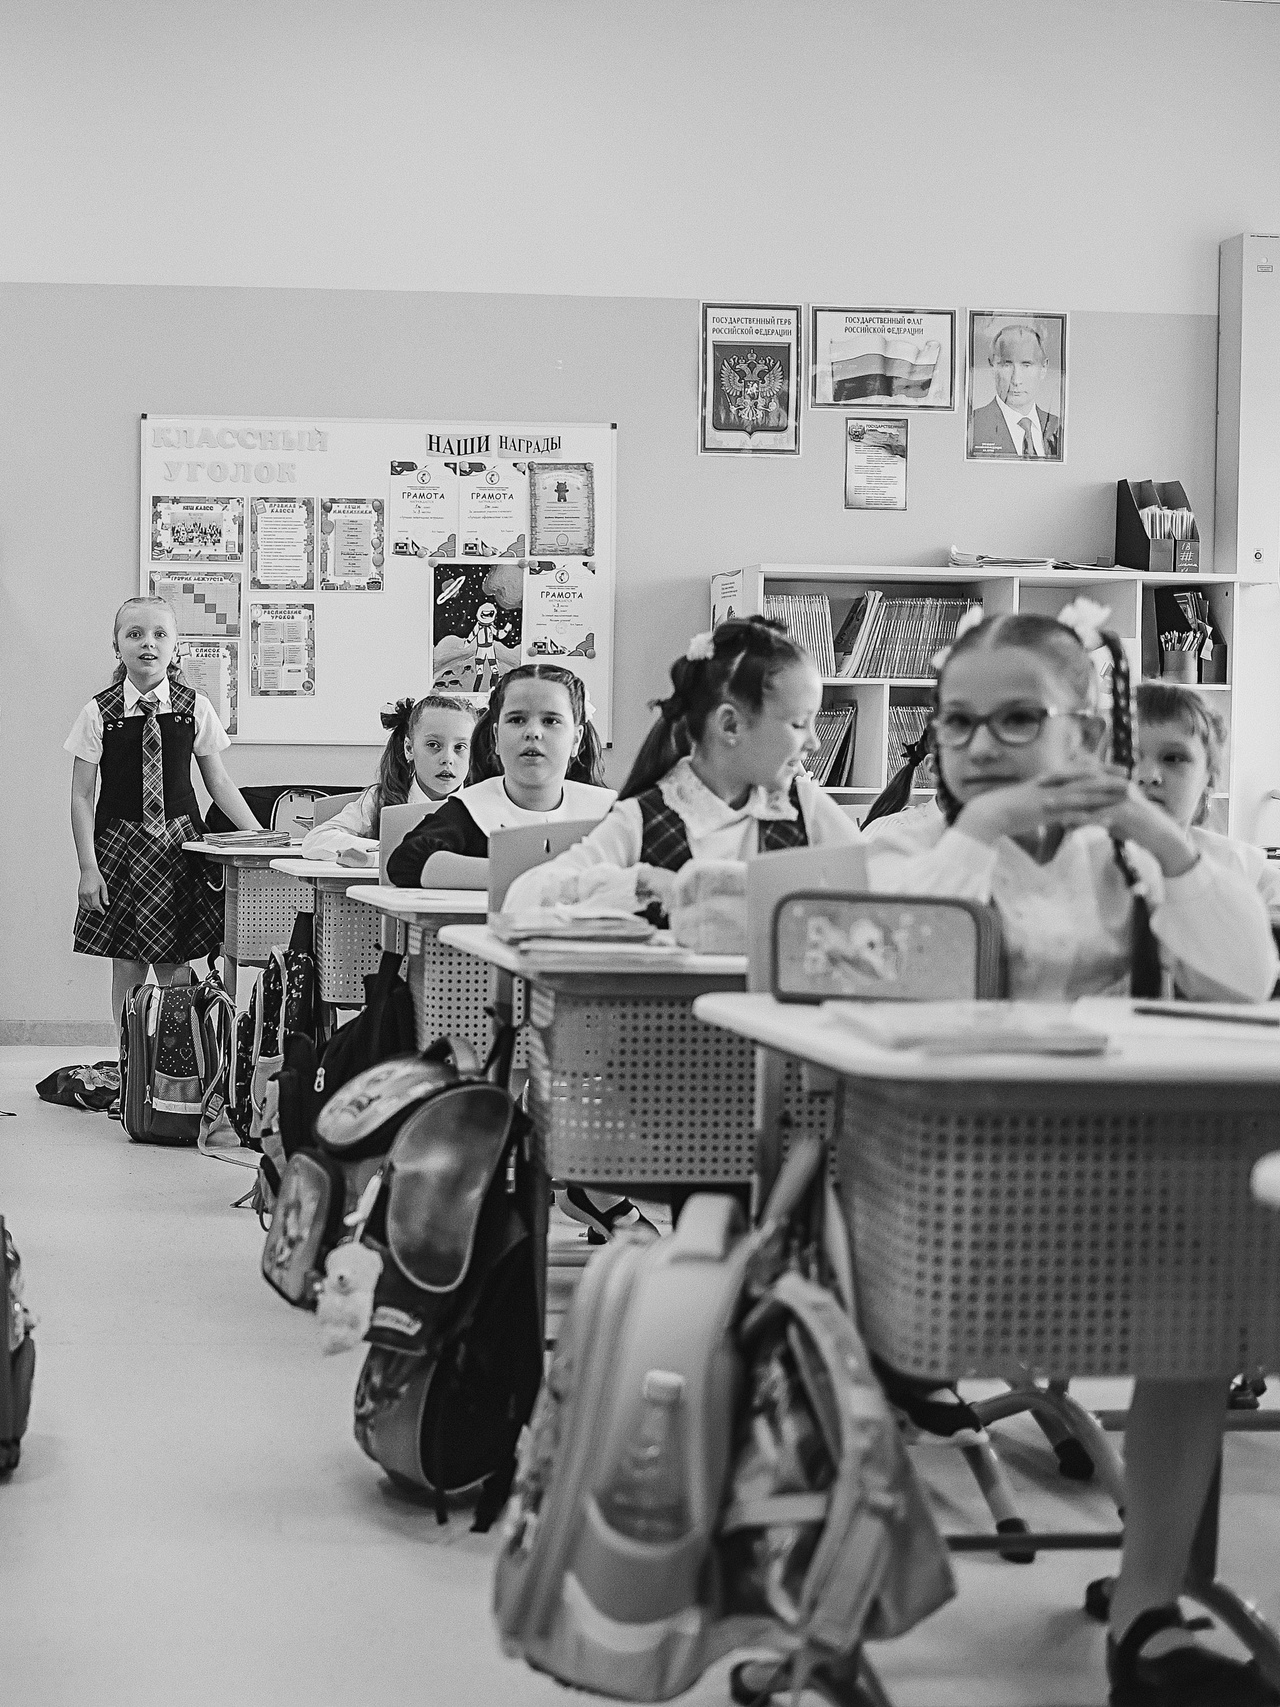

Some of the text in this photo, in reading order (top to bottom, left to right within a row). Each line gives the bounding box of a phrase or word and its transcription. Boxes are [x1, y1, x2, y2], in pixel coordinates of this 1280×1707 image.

[712, 316, 775, 325] ГОСУДАРСТВЕННЫЙ
[845, 316, 906, 325] ГОСУДАРСТВЕННЫЙ
[712, 326, 792, 337] РОССИЙСКОЙ ФЕДЕРАЦИИ
[844, 324, 924, 336] РОССИЙСКОЙ ФЕДЕРАЦИИ
[151, 427, 329, 452] КЛАССНЫЙ
[427, 433, 562, 456] НАШИ НАГРАДЫ
[163, 461, 297, 484] УГОЛОК
[402, 491, 445, 500] ГРАМОТА
[471, 492, 514, 500] ГРАМОТА
[540, 591, 583, 599] ГРАМОТА
